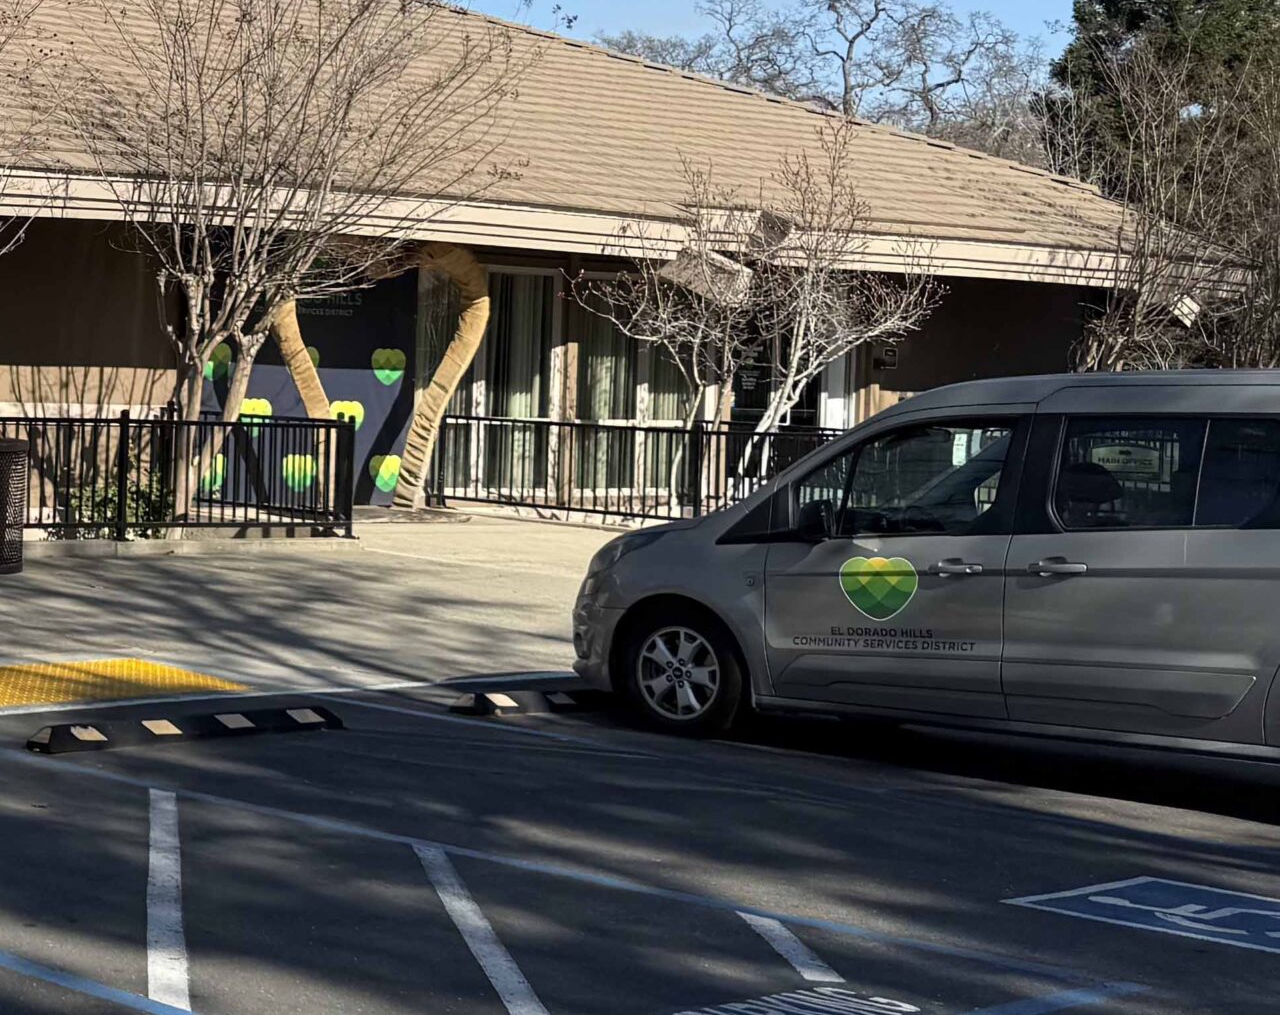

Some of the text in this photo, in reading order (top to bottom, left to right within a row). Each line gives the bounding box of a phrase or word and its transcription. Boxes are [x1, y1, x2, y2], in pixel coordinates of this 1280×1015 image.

[831, 626, 933, 638] EL DORADO HILLS
[793, 636, 976, 651] COMMUNITY SERVICES DISTRICT
